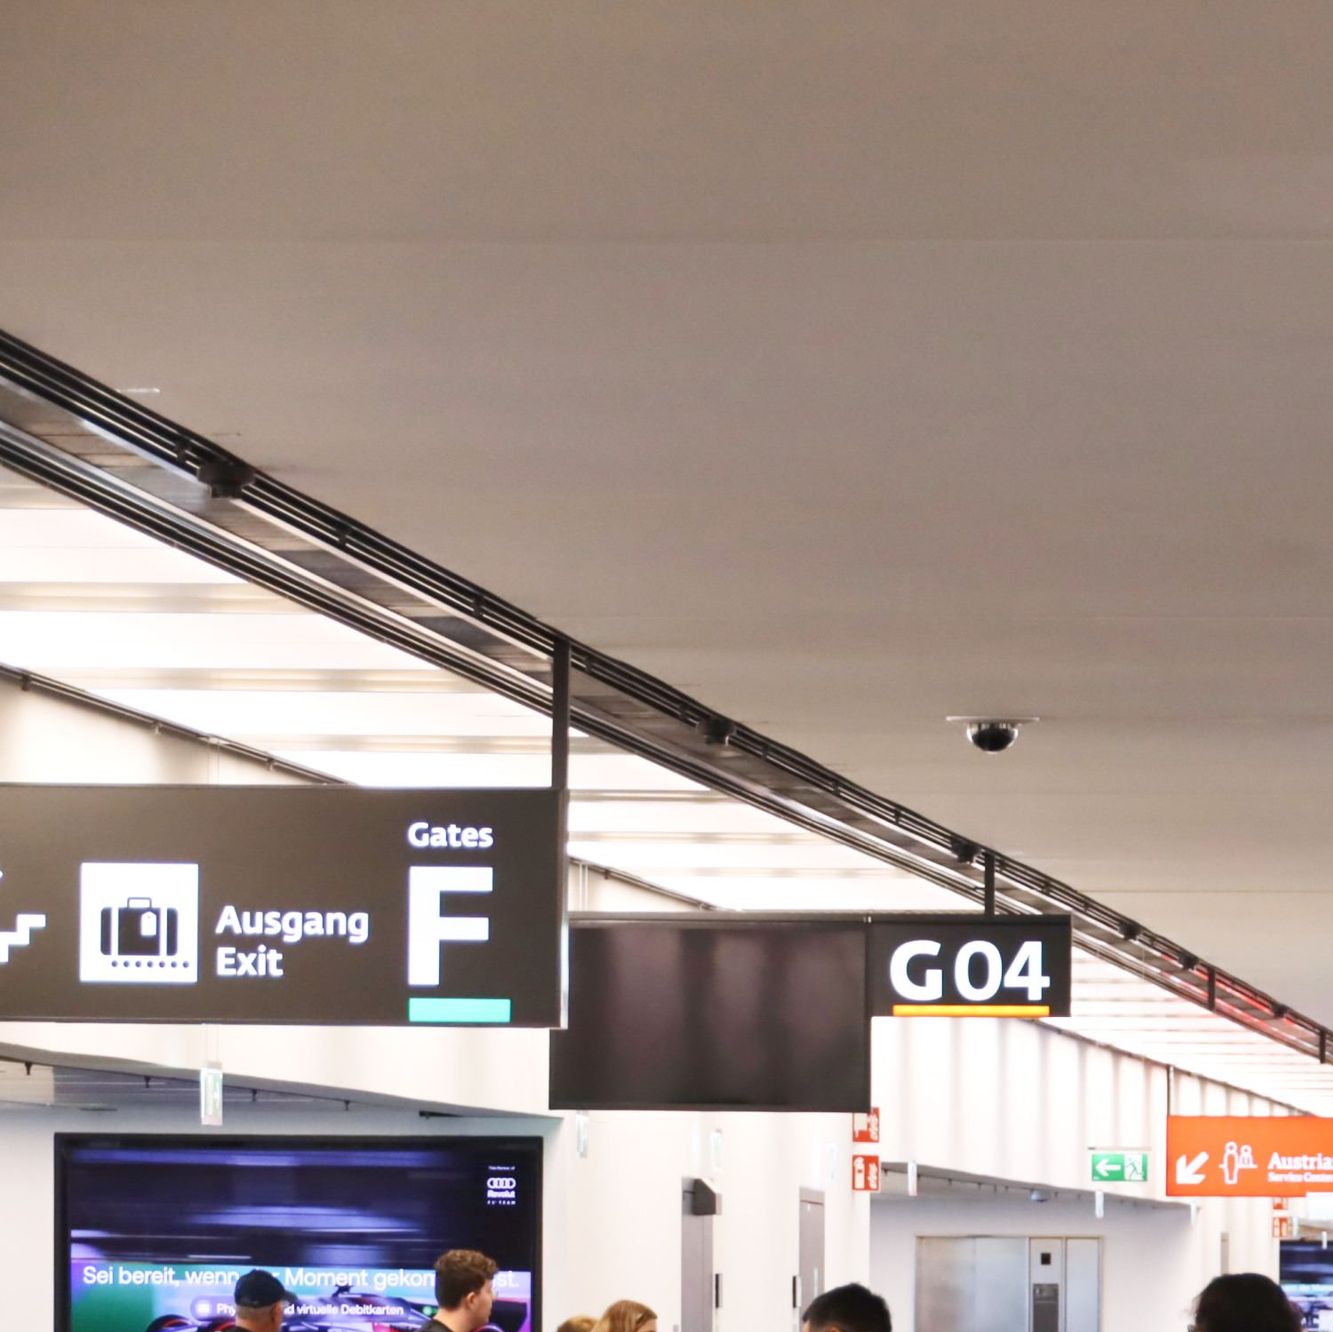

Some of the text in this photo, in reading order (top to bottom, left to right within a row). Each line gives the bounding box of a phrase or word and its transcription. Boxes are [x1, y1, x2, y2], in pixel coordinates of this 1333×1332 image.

[408, 821, 494, 848] Gates
[214, 904, 369, 944] Ausgang
[407, 865, 494, 986] F
[216, 943, 284, 977] Exit
[82, 1265, 114, 1285] Sei
[118, 1265, 181, 1288] bereit,
[184, 1269, 240, 1286] wenn
[284, 1267, 368, 1287] Moment
[297, 1303, 339, 1315] virtuelle
[341, 1303, 404, 1316] Debitkarten
